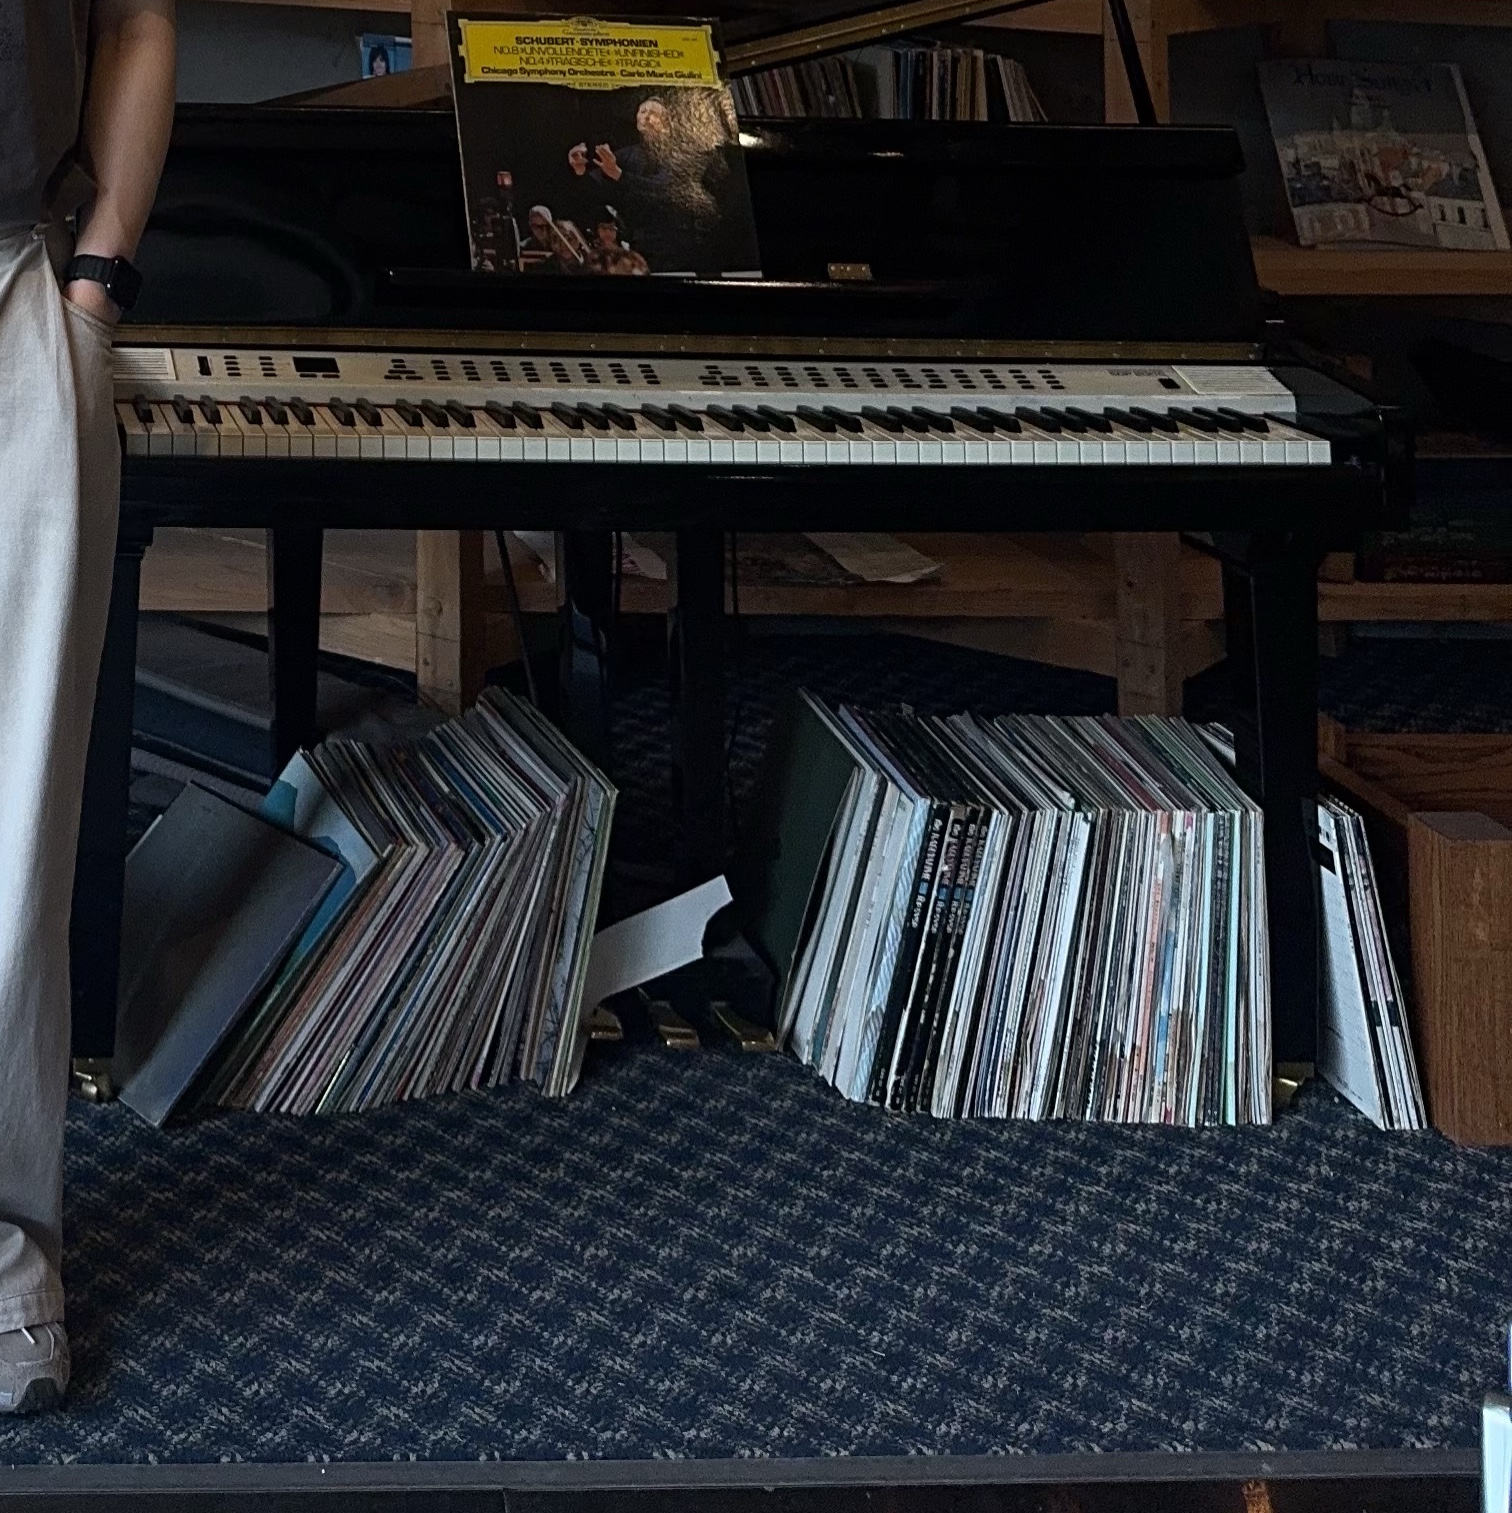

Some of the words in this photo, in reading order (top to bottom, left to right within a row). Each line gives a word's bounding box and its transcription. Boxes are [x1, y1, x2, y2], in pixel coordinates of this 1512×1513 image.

[515, 36, 575, 46] SCHUBERT
[580, 37, 658, 48] SYMPHONIEN
[481, 66, 518, 77] Chicago
[519, 67, 566, 77] Symphony
[568, 68, 615, 78] Orchestra
[620, 69, 645, 78] Carlo
[646, 70, 673, 79] Maria
[675, 70, 702, 80] Giulini
